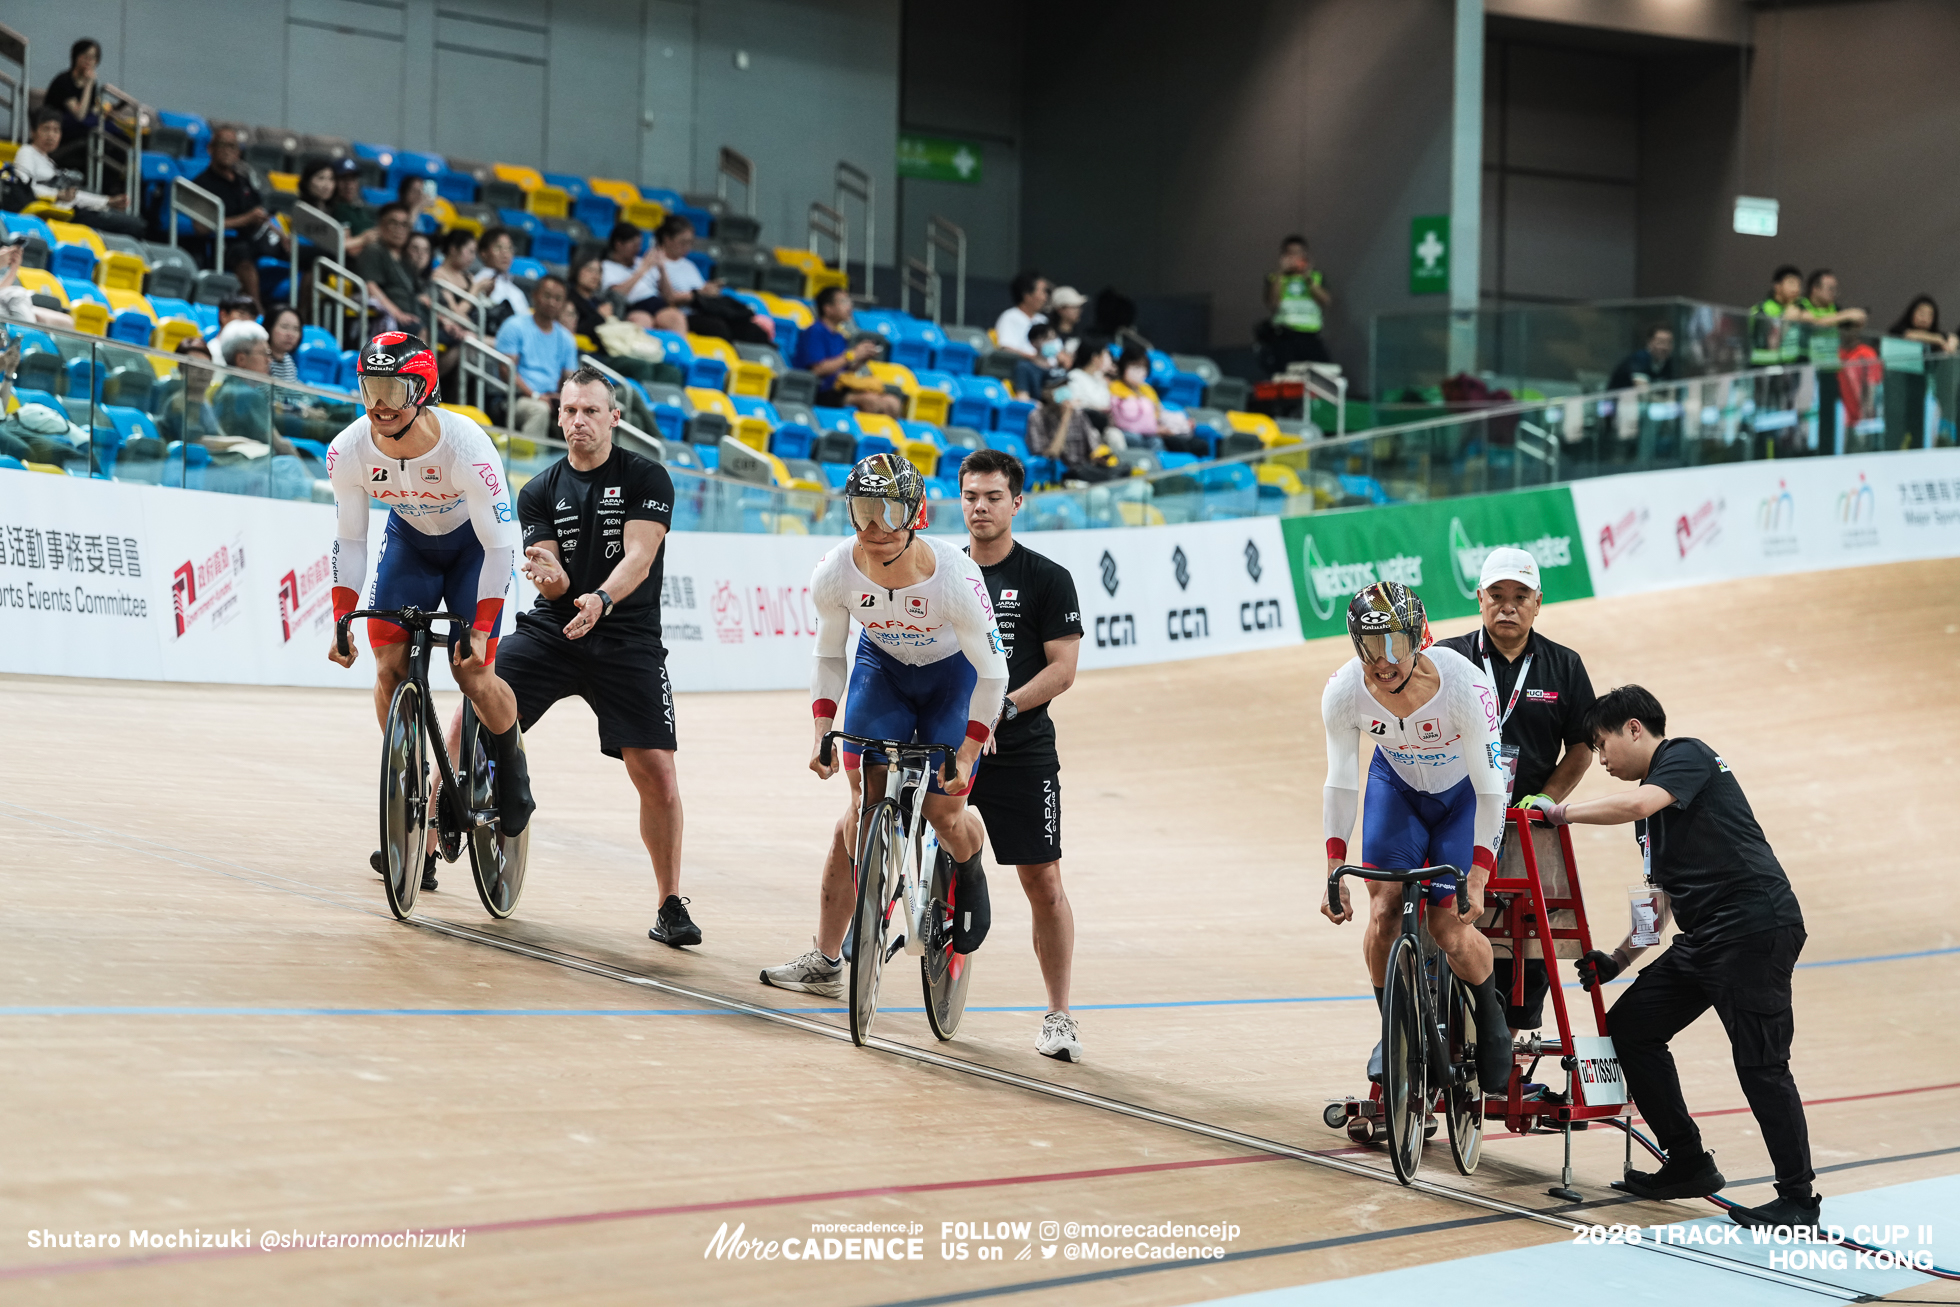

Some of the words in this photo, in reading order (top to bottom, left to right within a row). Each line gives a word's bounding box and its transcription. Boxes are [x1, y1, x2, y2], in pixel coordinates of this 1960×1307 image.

[27, 582, 72, 612] Events
[75, 586, 147, 617] Committee
[659, 666, 673, 733] JAPAN
[1485, 743, 1495, 769] KEIRIN
[1043, 780, 1053, 845] JAPAN
[1591, 1058, 1621, 1083] TISSOT
